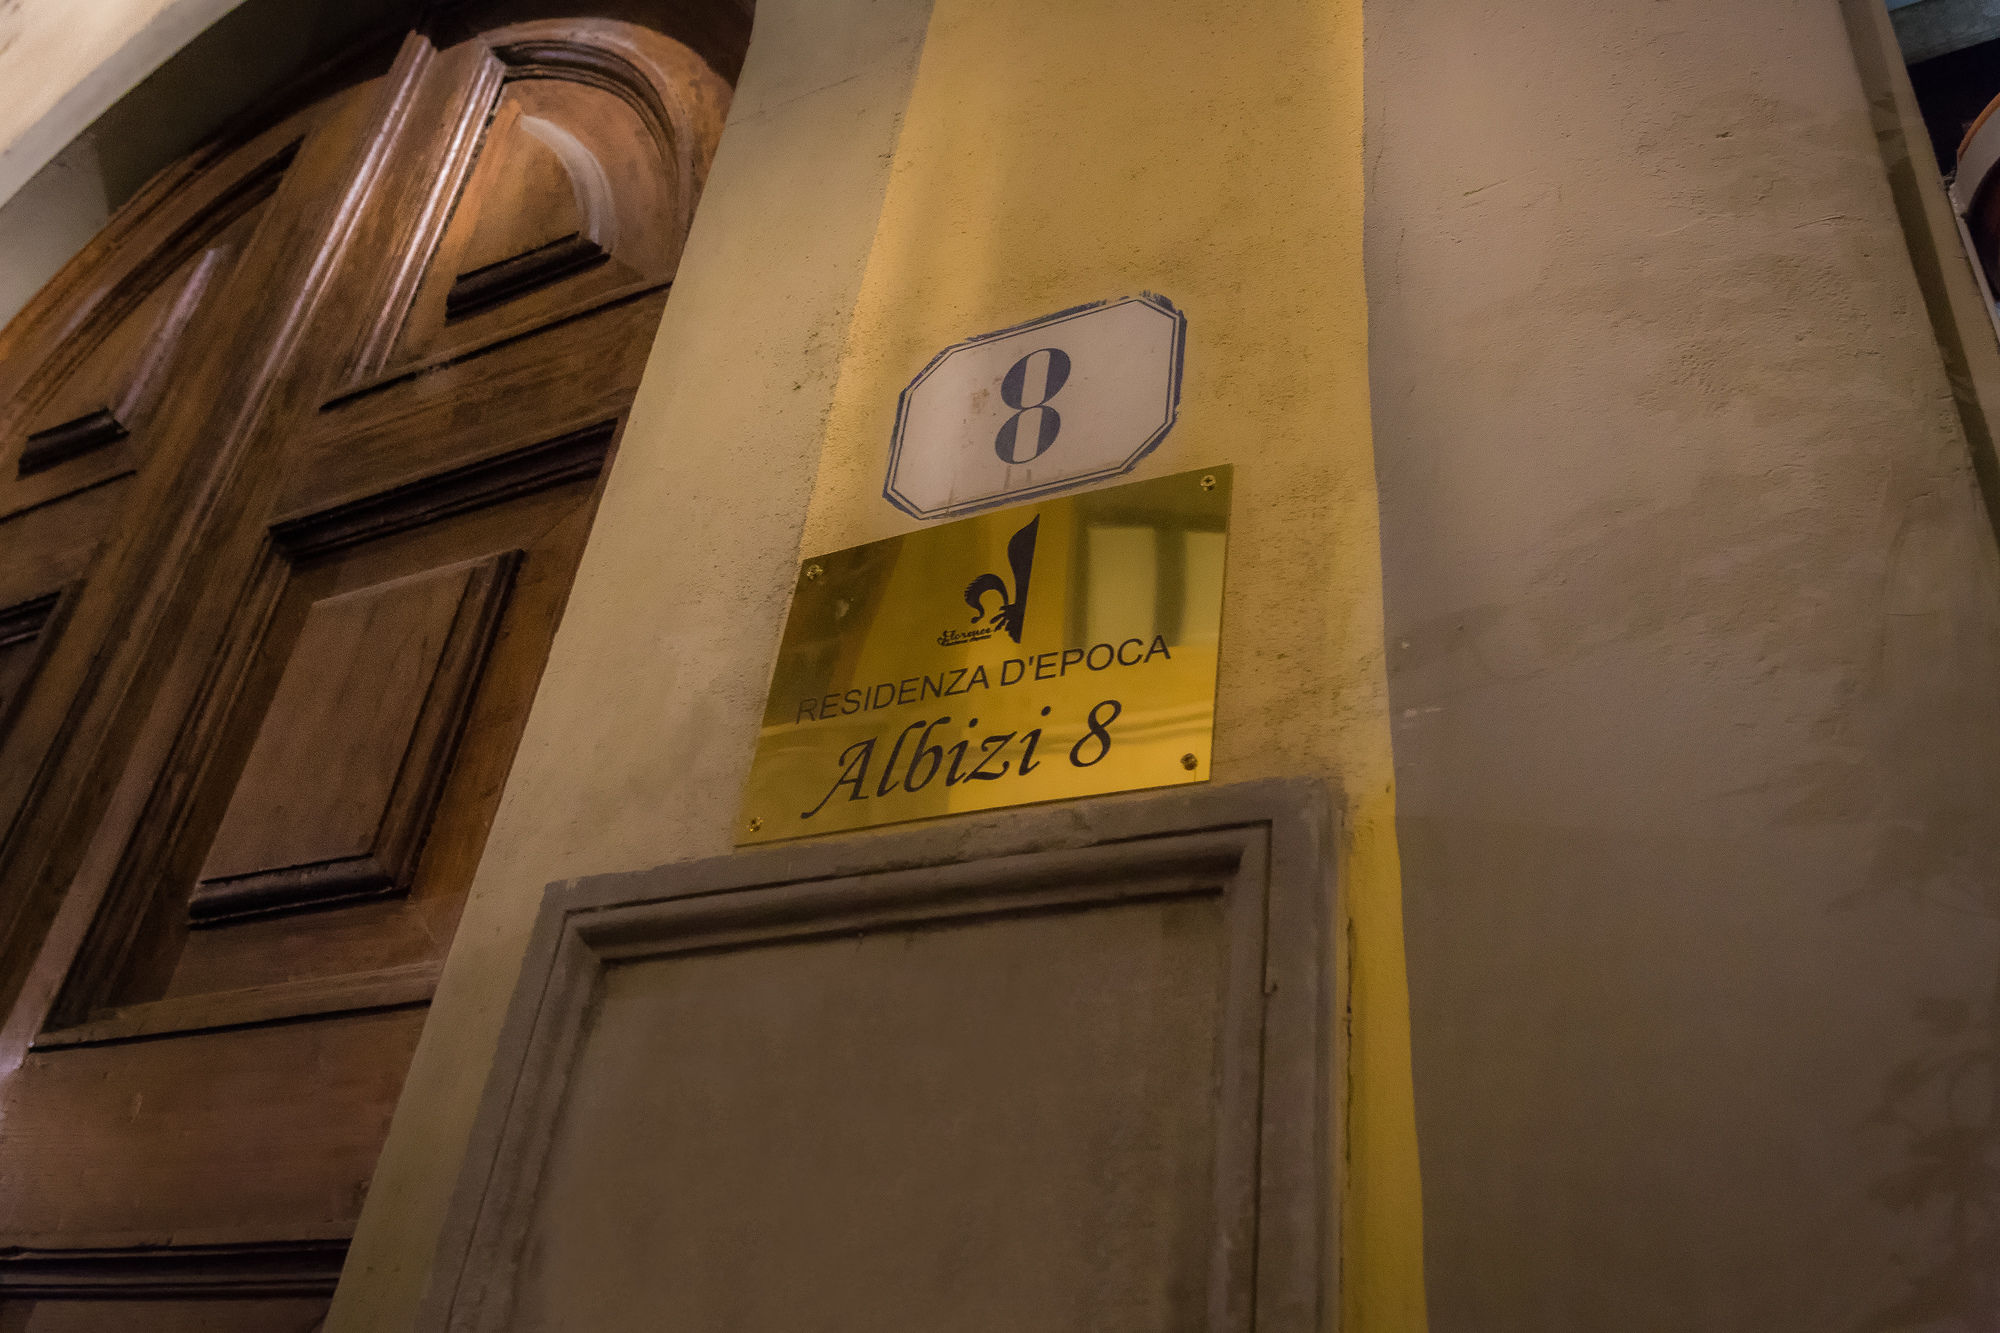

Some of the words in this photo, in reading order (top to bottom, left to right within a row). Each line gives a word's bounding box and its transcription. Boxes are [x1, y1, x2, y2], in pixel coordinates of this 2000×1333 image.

[995, 348, 1071, 464] 8
[796, 664, 989, 724] RESIDENZA
[1000, 634, 1171, 687] D'EPOCA
[801, 705, 1052, 819] Albizi
[1070, 700, 1122, 768] 8
